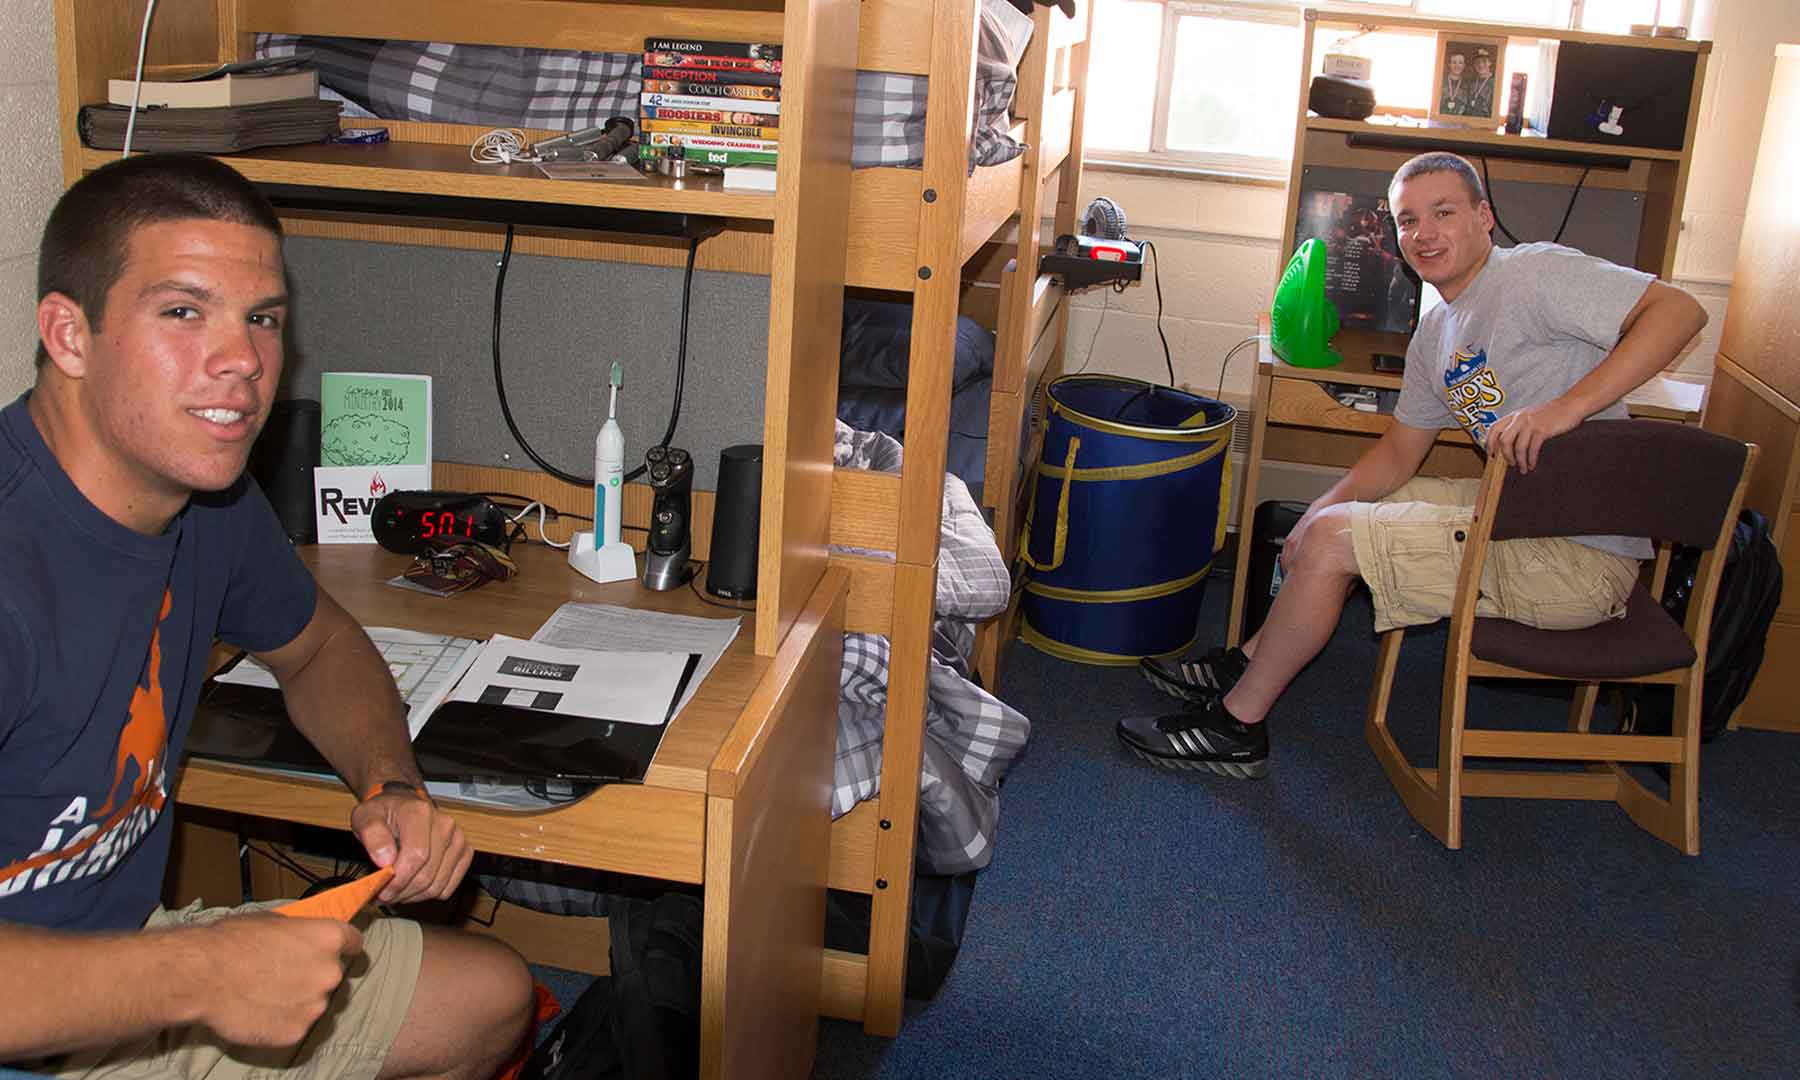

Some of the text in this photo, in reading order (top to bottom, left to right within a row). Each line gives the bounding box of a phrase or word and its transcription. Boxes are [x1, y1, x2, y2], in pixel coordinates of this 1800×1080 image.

[657, 42, 670, 50] AM
[672, 42, 703, 52] LEGEND
[652, 70, 717, 82] INCEPTION
[688, 83, 722, 96] COACH
[649, 95, 663, 106] 42
[657, 107, 721, 123] HOOSIERS
[711, 124, 762, 138] INVINCIBLE
[708, 151, 728, 163] ted
[382, 397, 404, 412] 2014
[513, 665, 562, 678] BILLING
